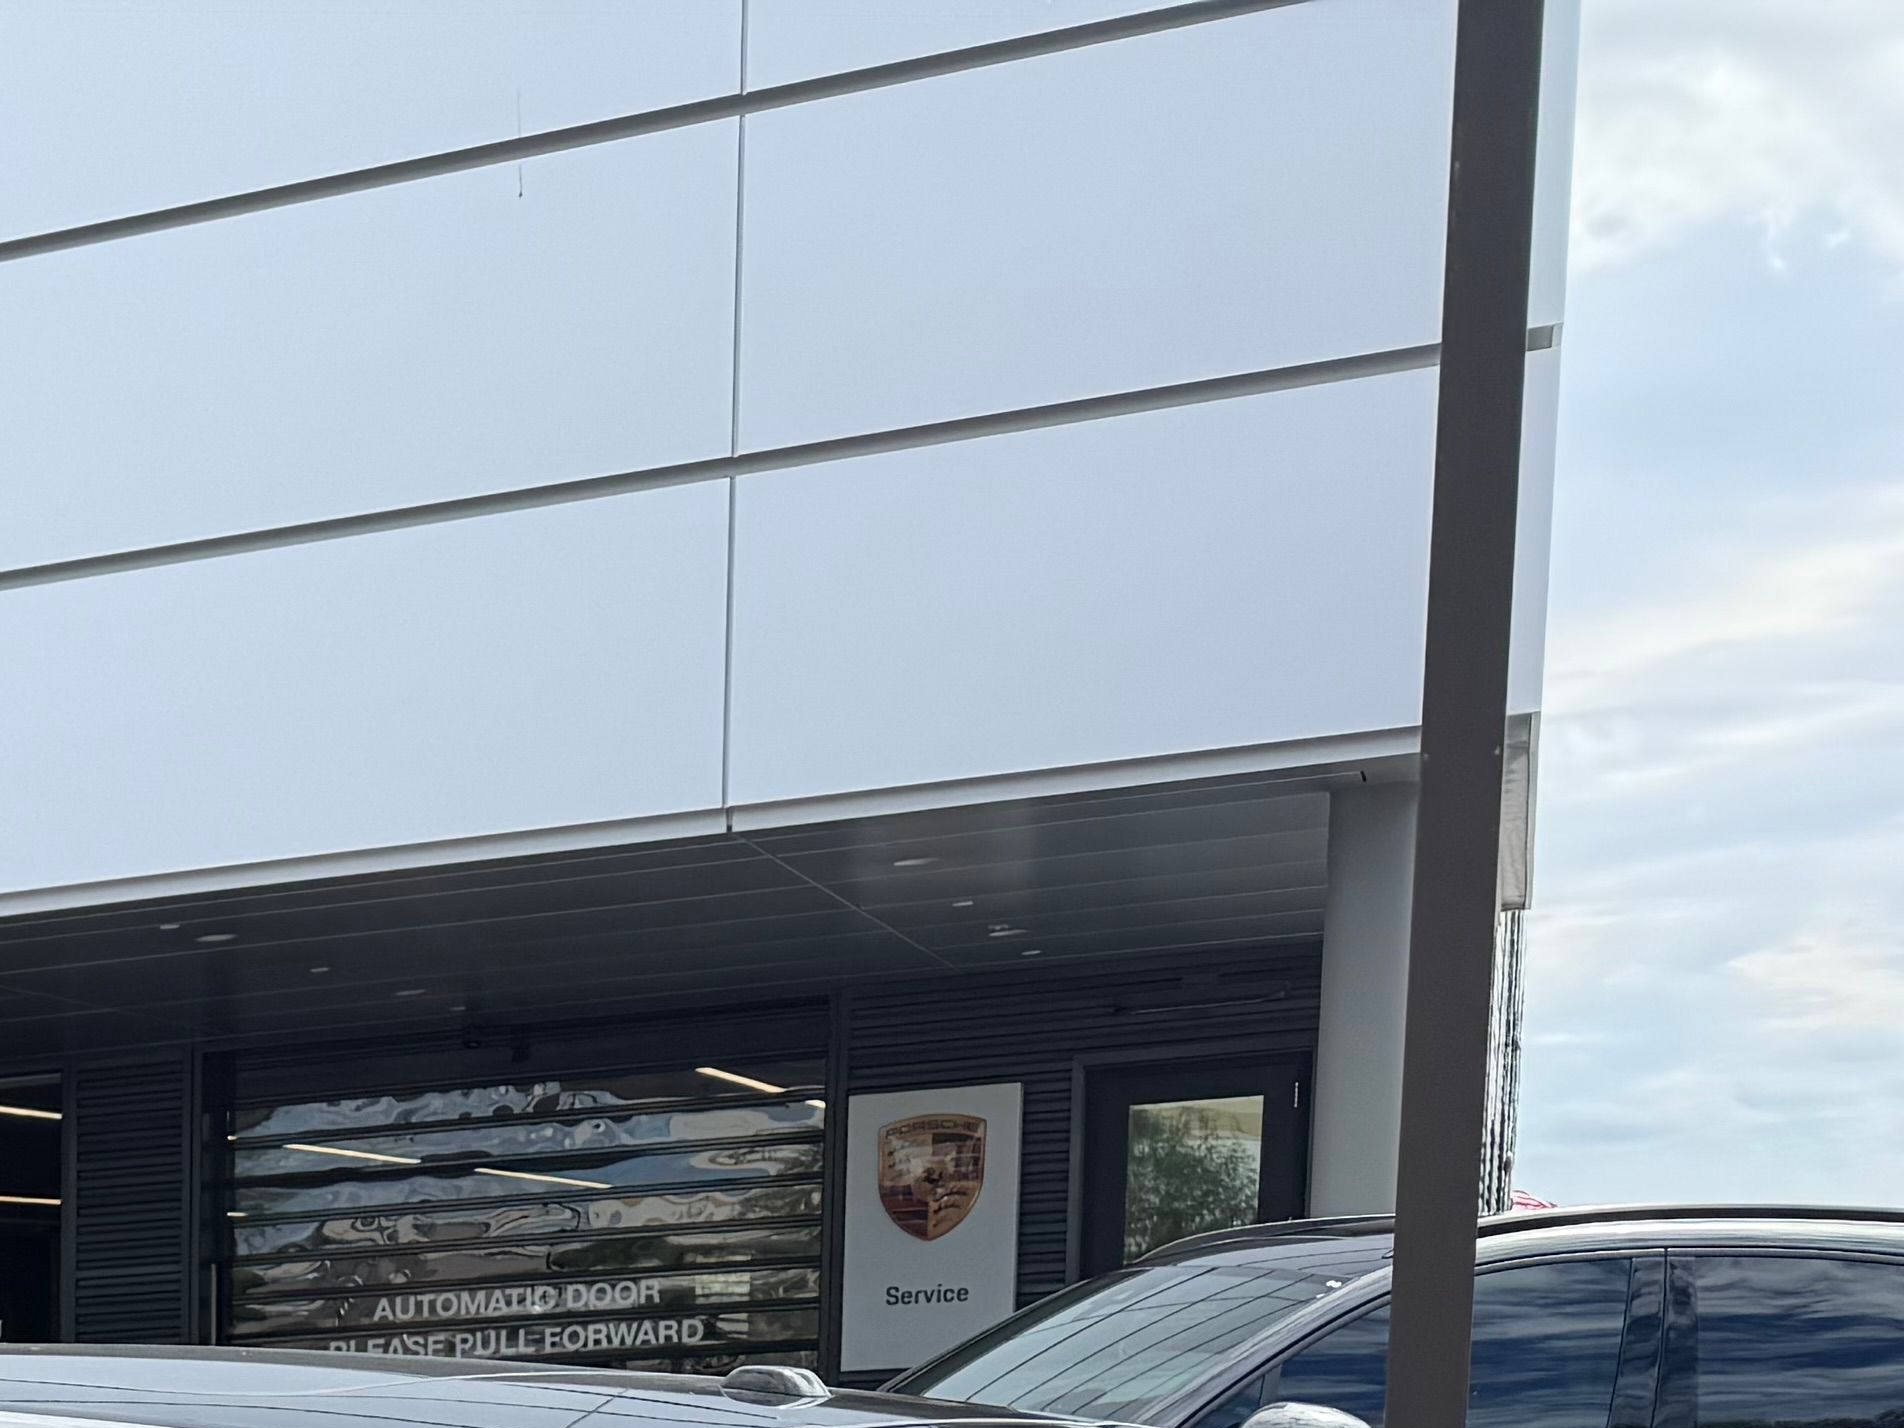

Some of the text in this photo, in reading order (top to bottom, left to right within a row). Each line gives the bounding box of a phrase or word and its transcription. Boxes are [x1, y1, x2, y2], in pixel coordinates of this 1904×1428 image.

[886, 1117, 980, 1140] PORSCHE
[373, 1280, 662, 1322] AUTOMATIC DOOR
[885, 1282, 969, 1306] Service
[455, 1327, 537, 1359] PULL
[544, 1319, 707, 1352] FORWARD
